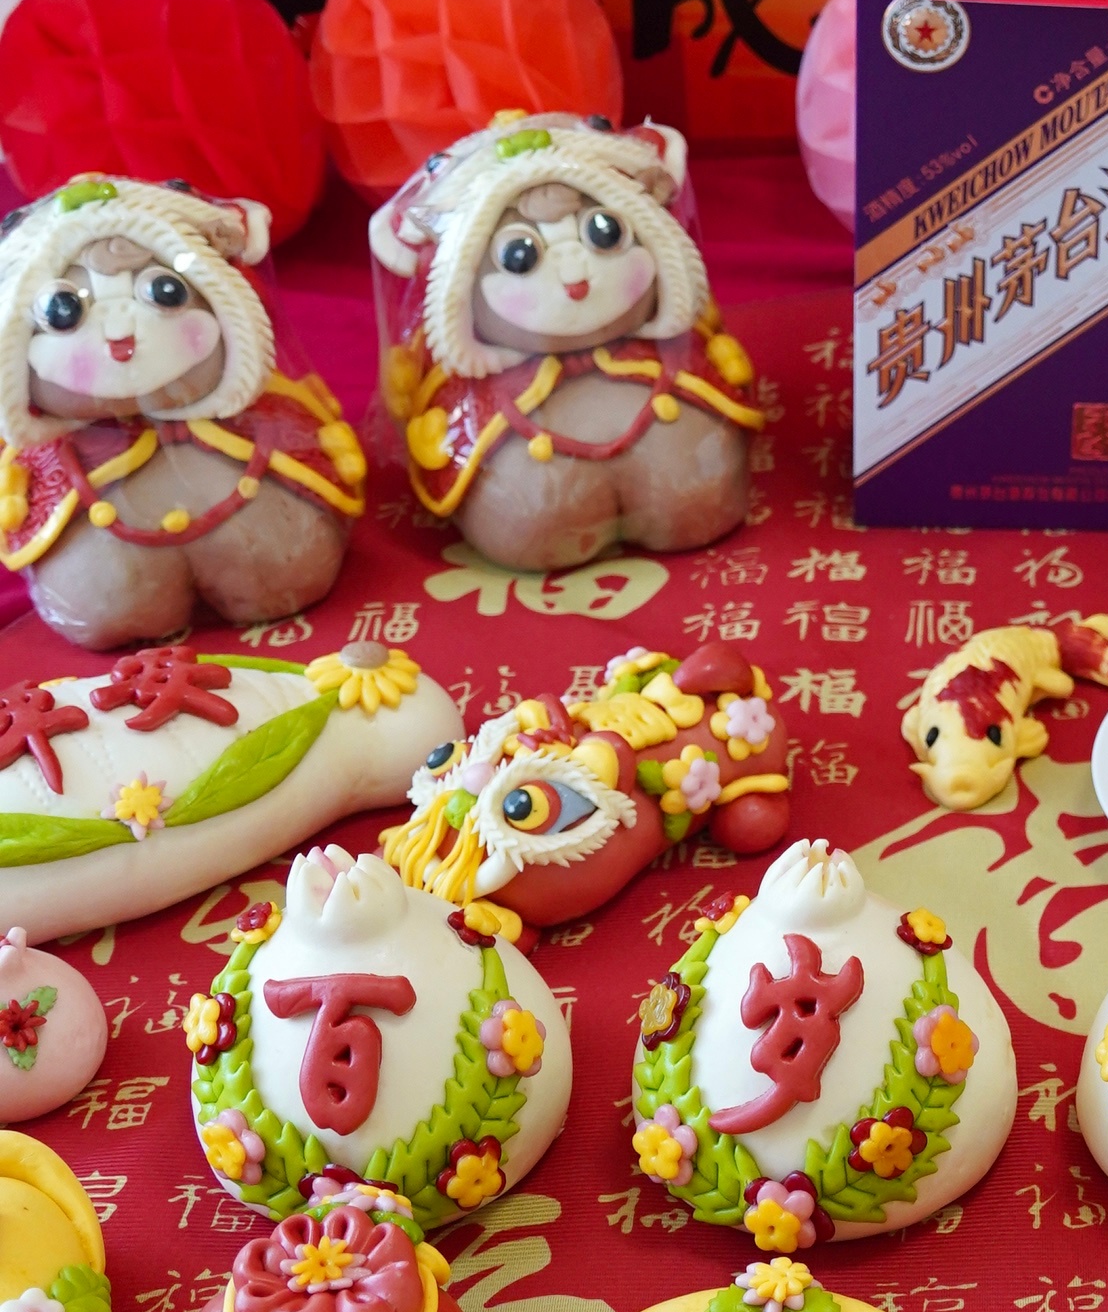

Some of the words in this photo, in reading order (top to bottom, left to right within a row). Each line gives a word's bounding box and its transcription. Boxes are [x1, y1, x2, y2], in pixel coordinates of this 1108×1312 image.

[912, 132, 1034, 241] KWEICHOW
[263, 972, 417, 1136] 百
[708, 934, 865, 1133] 岁
